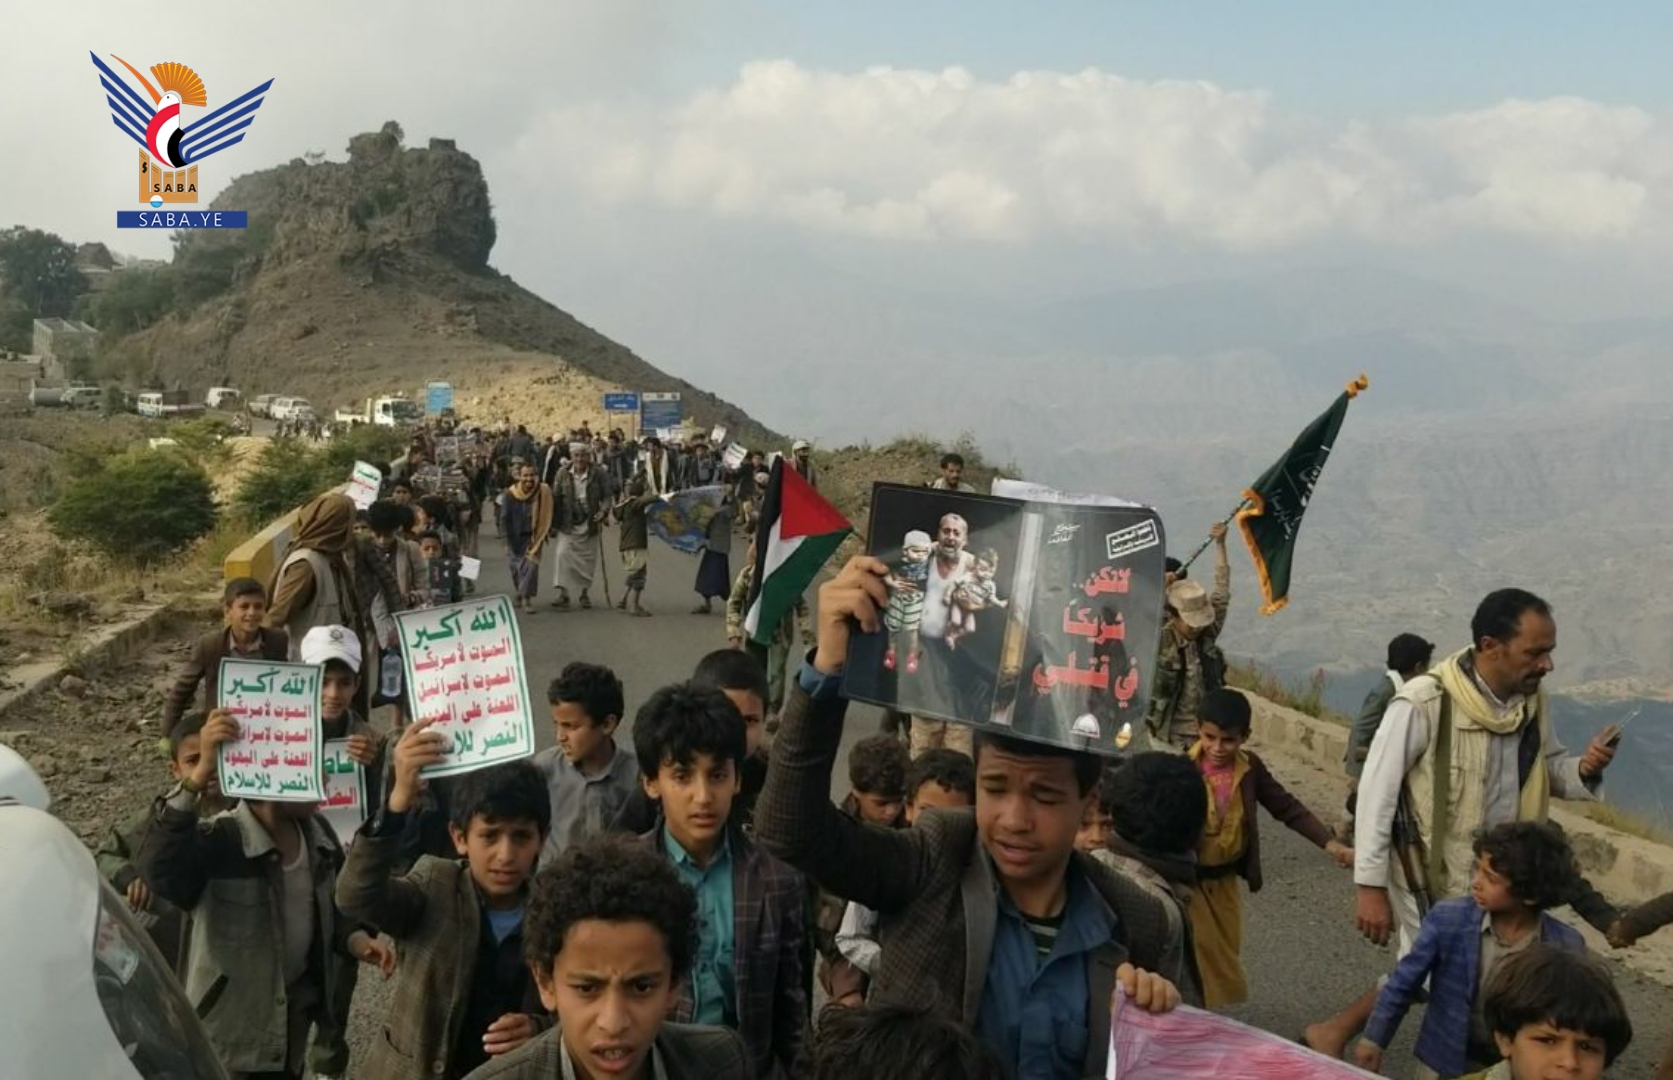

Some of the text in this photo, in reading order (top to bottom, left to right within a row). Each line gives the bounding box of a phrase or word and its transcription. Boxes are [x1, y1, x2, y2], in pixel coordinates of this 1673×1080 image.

[471, 602, 507, 632] الله
[470, 636, 511, 663] الموت
[280, 672, 314, 695] الله
[473, 665, 516, 691] الموت
[274, 704, 312, 721] الموت
[487, 694, 520, 715] اللعنة
[274, 727, 312, 746] الموت
[480, 721, 524, 756] النصر
[225, 750, 258, 767] اليهود
[284, 750, 312, 767] اللعنة
[228, 771, 315, 794] النصر للإسلام
